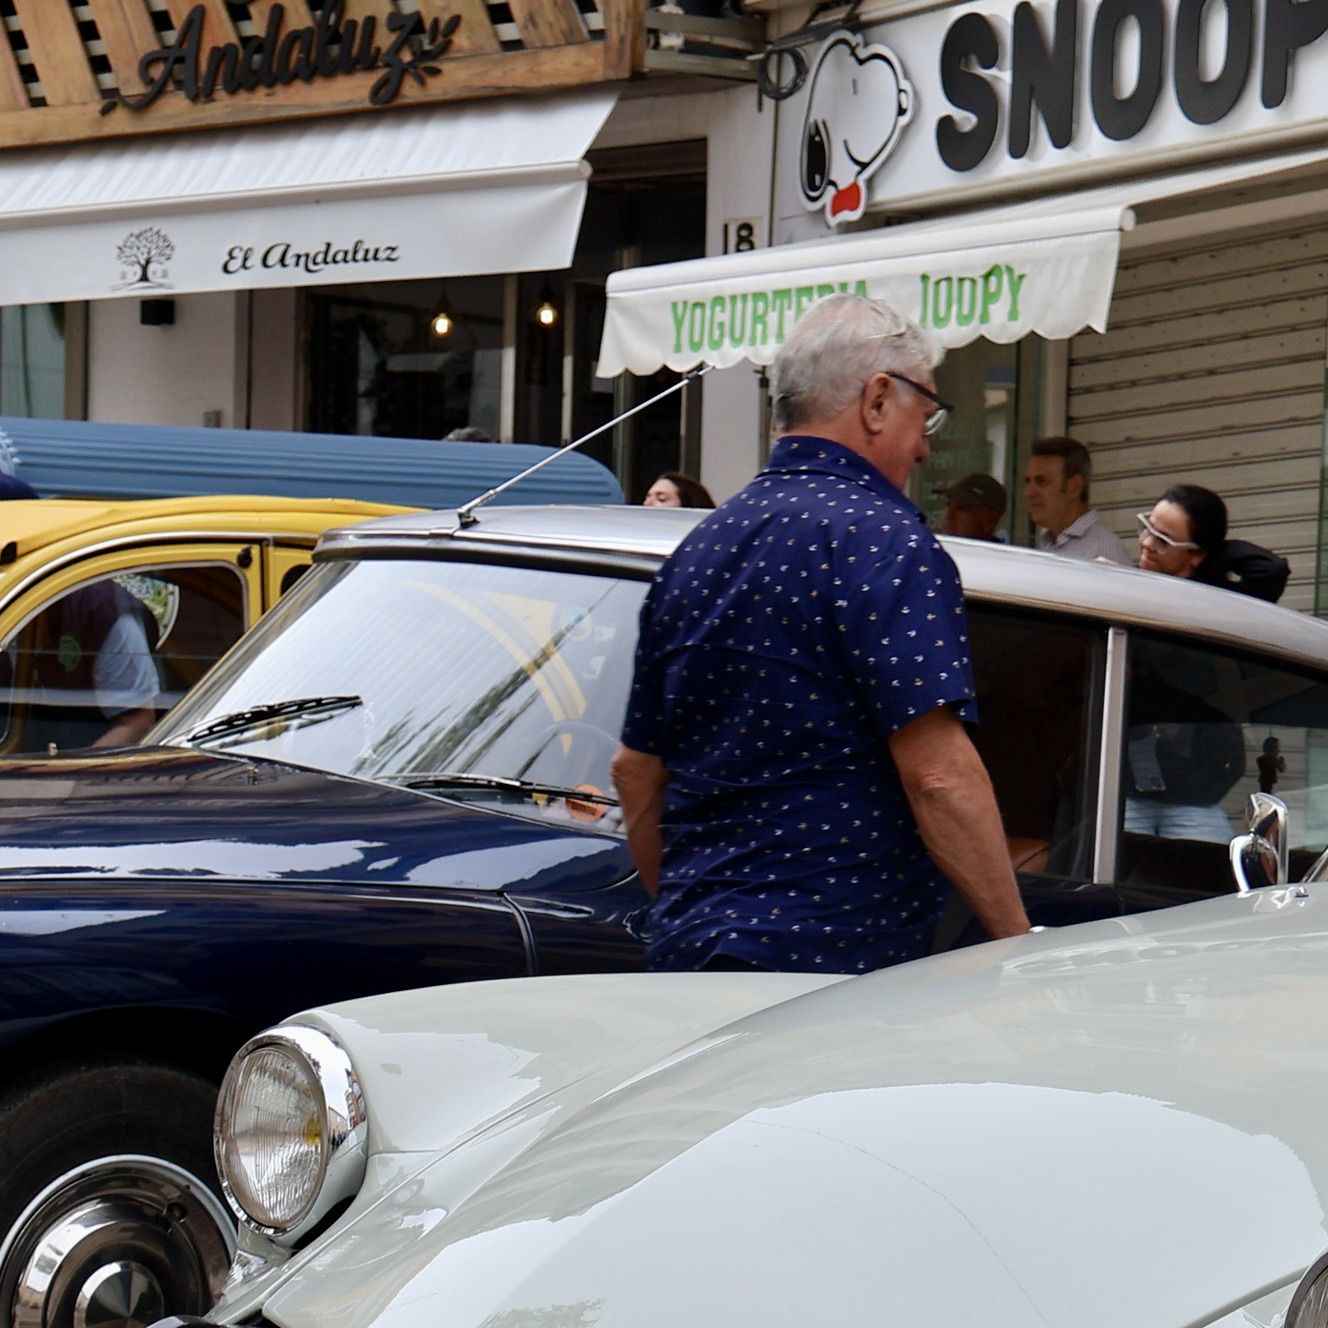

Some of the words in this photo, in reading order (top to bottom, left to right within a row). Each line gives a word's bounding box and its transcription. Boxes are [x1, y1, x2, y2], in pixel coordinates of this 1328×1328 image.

[112, 0, 420, 112] Andaluz
[222, 246, 254, 274] El
[262, 239, 399, 273] Andaluz
